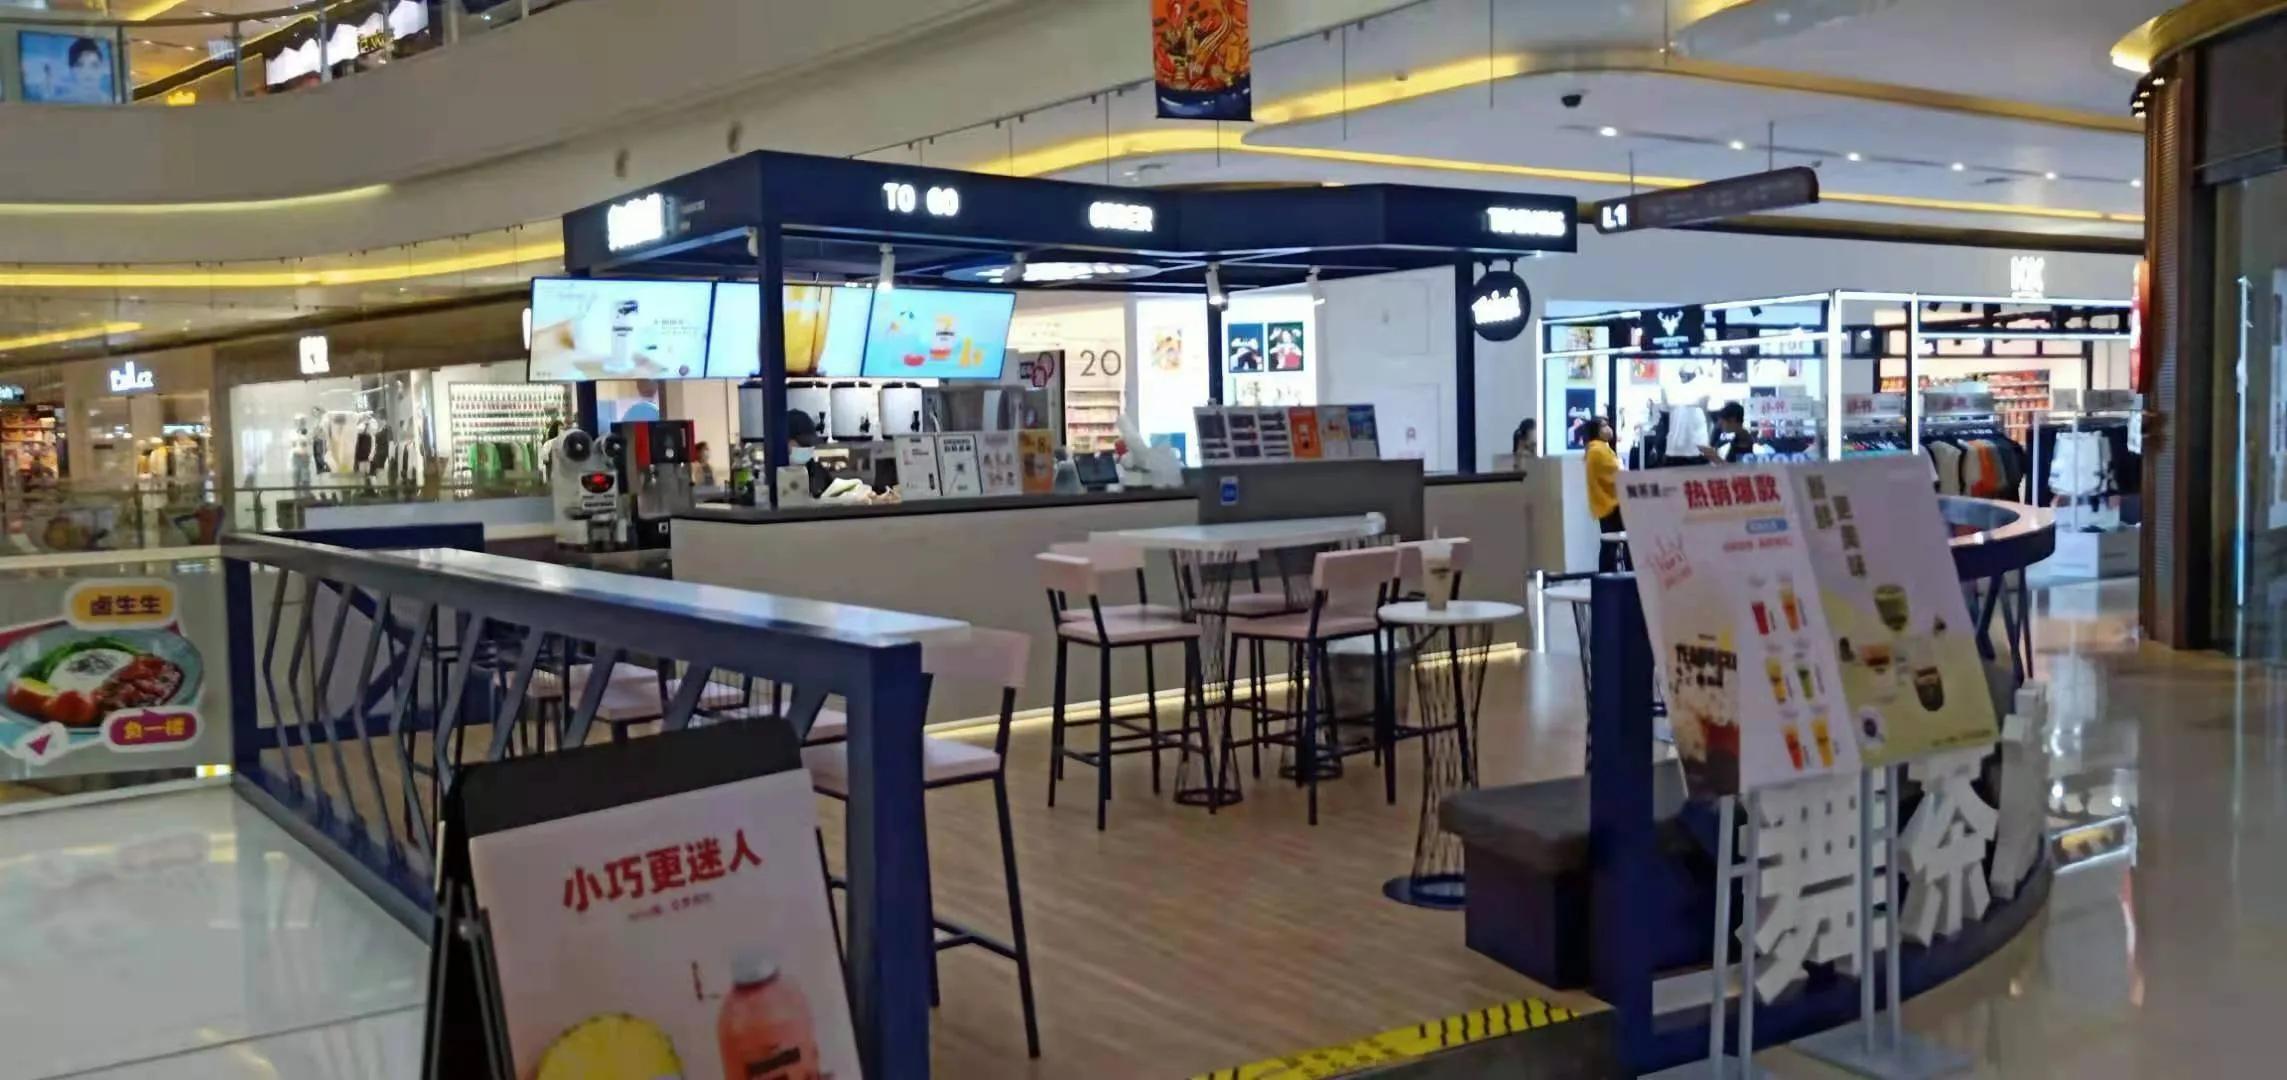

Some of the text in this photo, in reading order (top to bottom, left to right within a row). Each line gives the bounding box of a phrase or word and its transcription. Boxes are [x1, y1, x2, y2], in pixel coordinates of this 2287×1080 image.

[882, 182, 959, 217] TO GO
[1601, 203, 1628, 229] L1
[1079, 349, 1122, 377] 20
[1683, 473, 1781, 510] 热销爆款
[561, 828, 764, 914] 小巧更迷人
